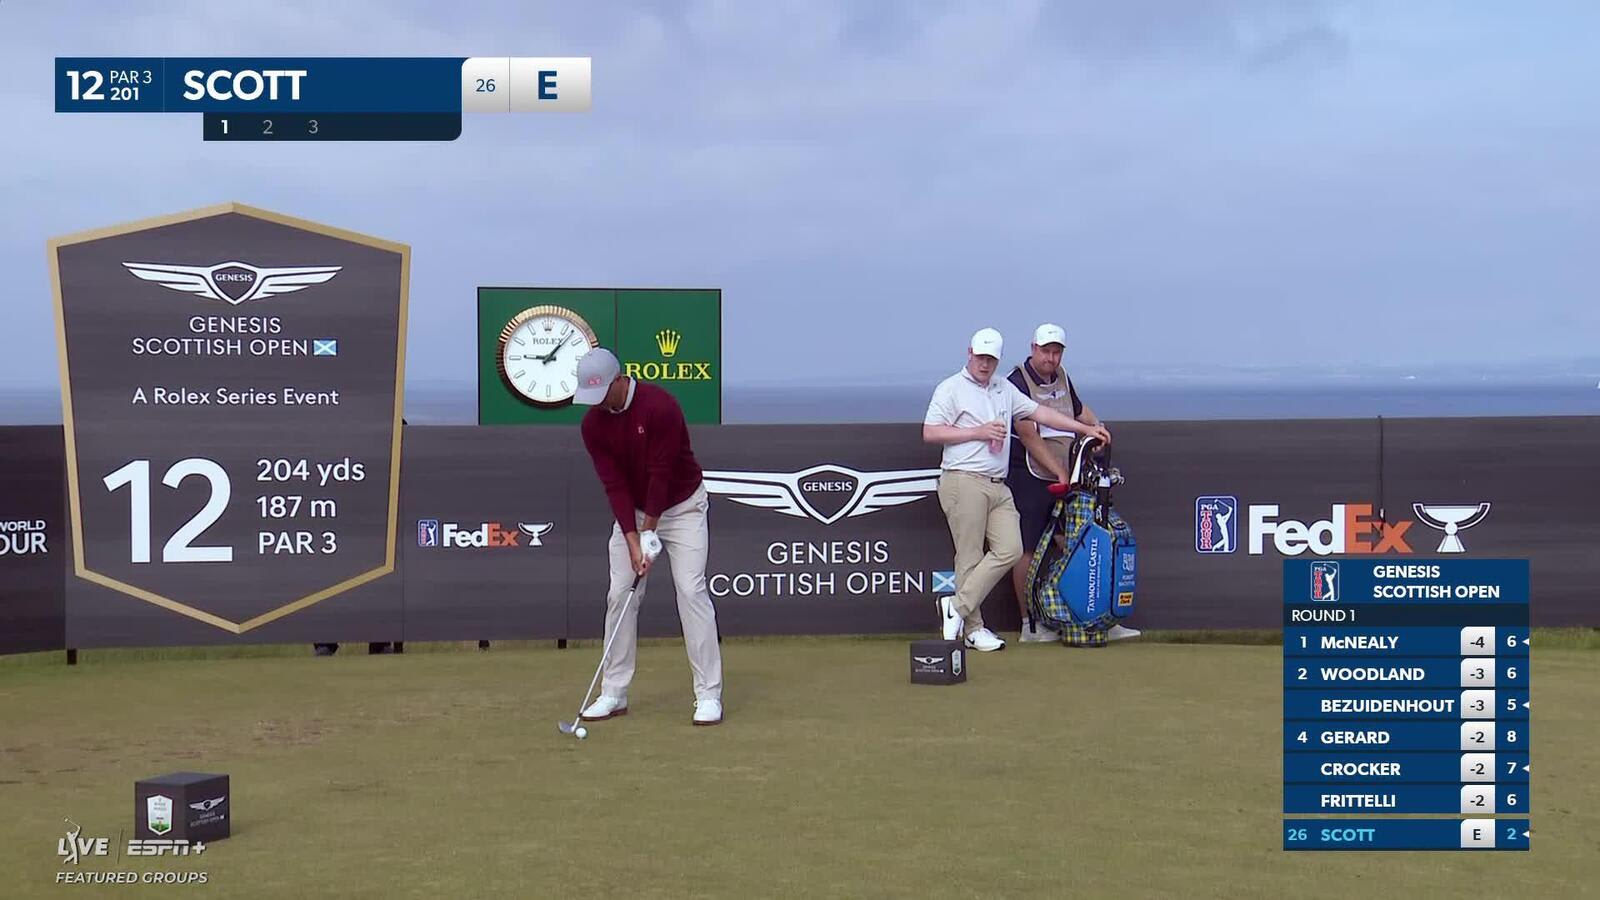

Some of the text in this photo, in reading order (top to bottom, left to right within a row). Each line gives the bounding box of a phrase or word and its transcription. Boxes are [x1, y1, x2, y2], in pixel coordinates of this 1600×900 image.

[215, 273, 253, 282] GENESIS
[189, 316, 281, 334] GENESIS
[132, 337, 308, 356] SCOTTISH OPEN
[624, 361, 712, 380] ROLEX
[132, 387, 339, 405] A Rolex Series Event
[257, 457, 366, 487] 204 yds
[802, 481, 853, 492] GENESIS
[102, 458, 233, 563] 12
[256, 495, 336, 518] 187 m
[443, 523, 518, 547] FedEx
[1201, 511, 1212, 549] TOUR
[1249, 503, 1414, 555] FedEx
[0, 532, 48, 555] OUR
[259, 531, 337, 554] PAR 3
[767, 540, 888, 565] GENESIS
[709, 573, 835, 597] COTTISH
[846, 571, 923, 594] OPEN
